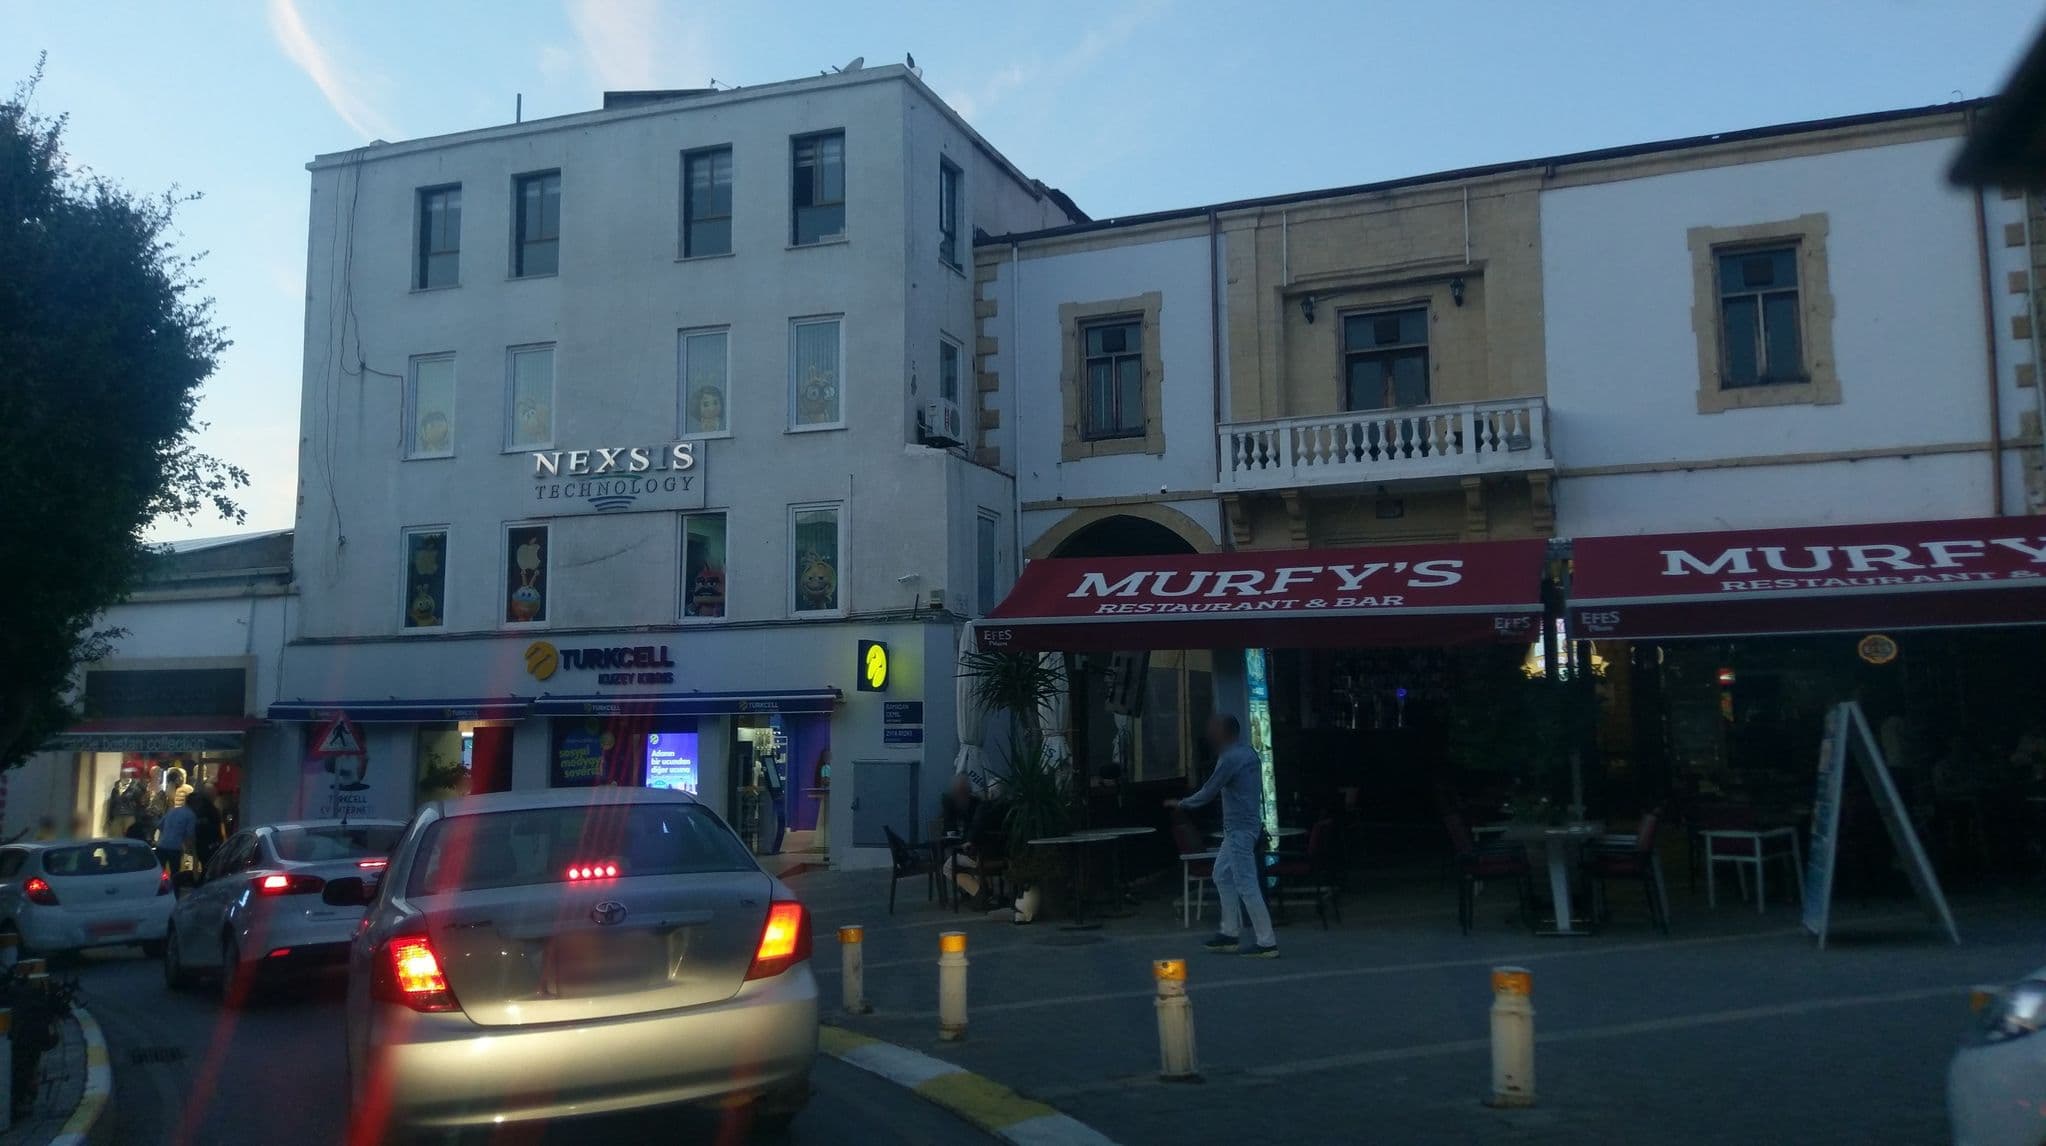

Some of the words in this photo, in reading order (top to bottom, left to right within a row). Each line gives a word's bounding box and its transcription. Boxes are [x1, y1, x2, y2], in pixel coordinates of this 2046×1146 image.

[534, 476, 694, 500] TECHNOLOGY
[1066, 560, 1464, 598] MURFY'S
[1719, 571, 1997, 591] RESTAURANT
[2008, 570, 2042, 579] &
[1095, 599, 1300, 615] RESTAURANT
[1304, 598, 1328, 609] &
[1333, 595, 1405, 608] BAR
[1494, 615, 1531, 630] EFES
[1582, 611, 1620, 625] EFES
[983, 629, 1013, 641] EFES
[559, 645, 675, 671] TURKCELL
[592, 703, 621, 713] TURKCELL
